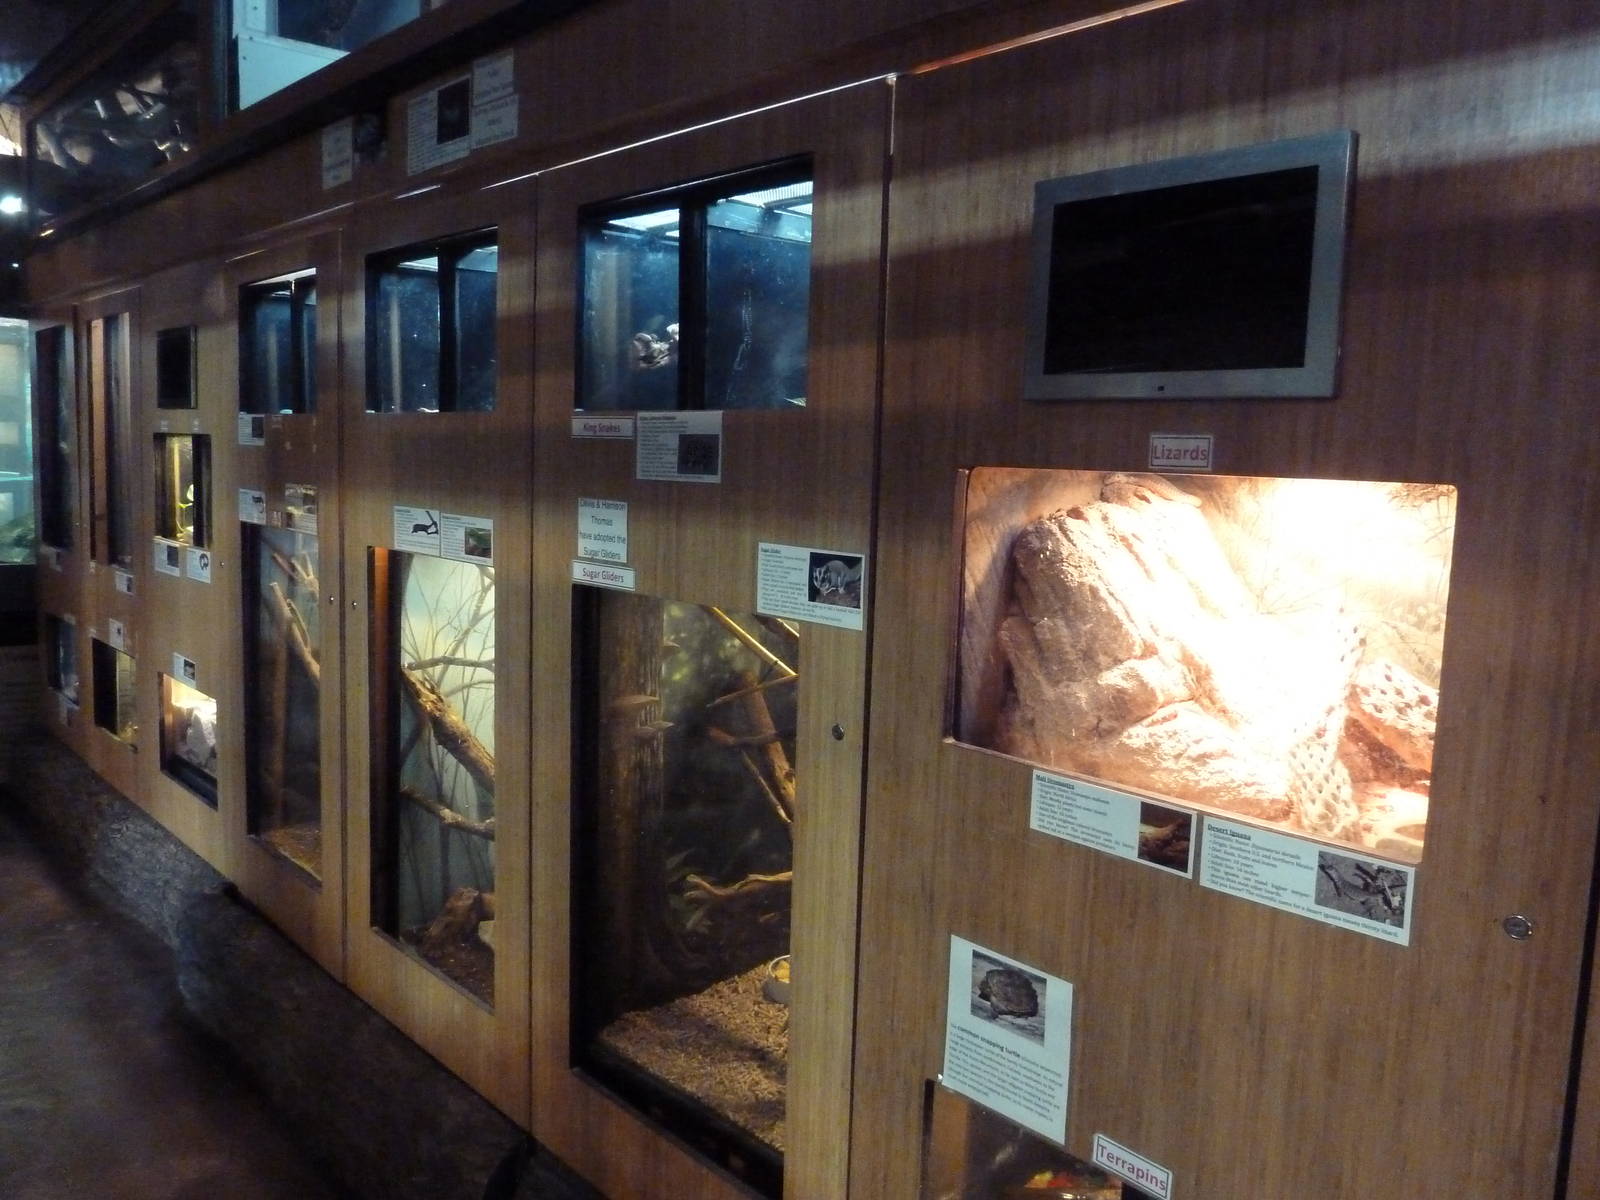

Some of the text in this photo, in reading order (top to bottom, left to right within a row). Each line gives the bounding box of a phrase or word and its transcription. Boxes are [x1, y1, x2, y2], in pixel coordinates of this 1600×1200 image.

[583, 423, 620, 434] King Snakes
[1153, 444, 1207, 460] Lizards
[591, 516, 613, 526] Thomas
[593, 533, 616, 543] adopted
[617, 535, 626, 544] the
[584, 547, 621, 560] Sugar Gliders
[583, 568, 624, 583] Sugar Gliders
[1208, 824, 1229, 835] Desert
[1229, 829, 1251, 840] Iguana
[980, 1036, 1005, 1052] snapping
[1005, 1046, 1021, 1058] turtle
[1097, 1144, 1166, 1190] Terrapins
